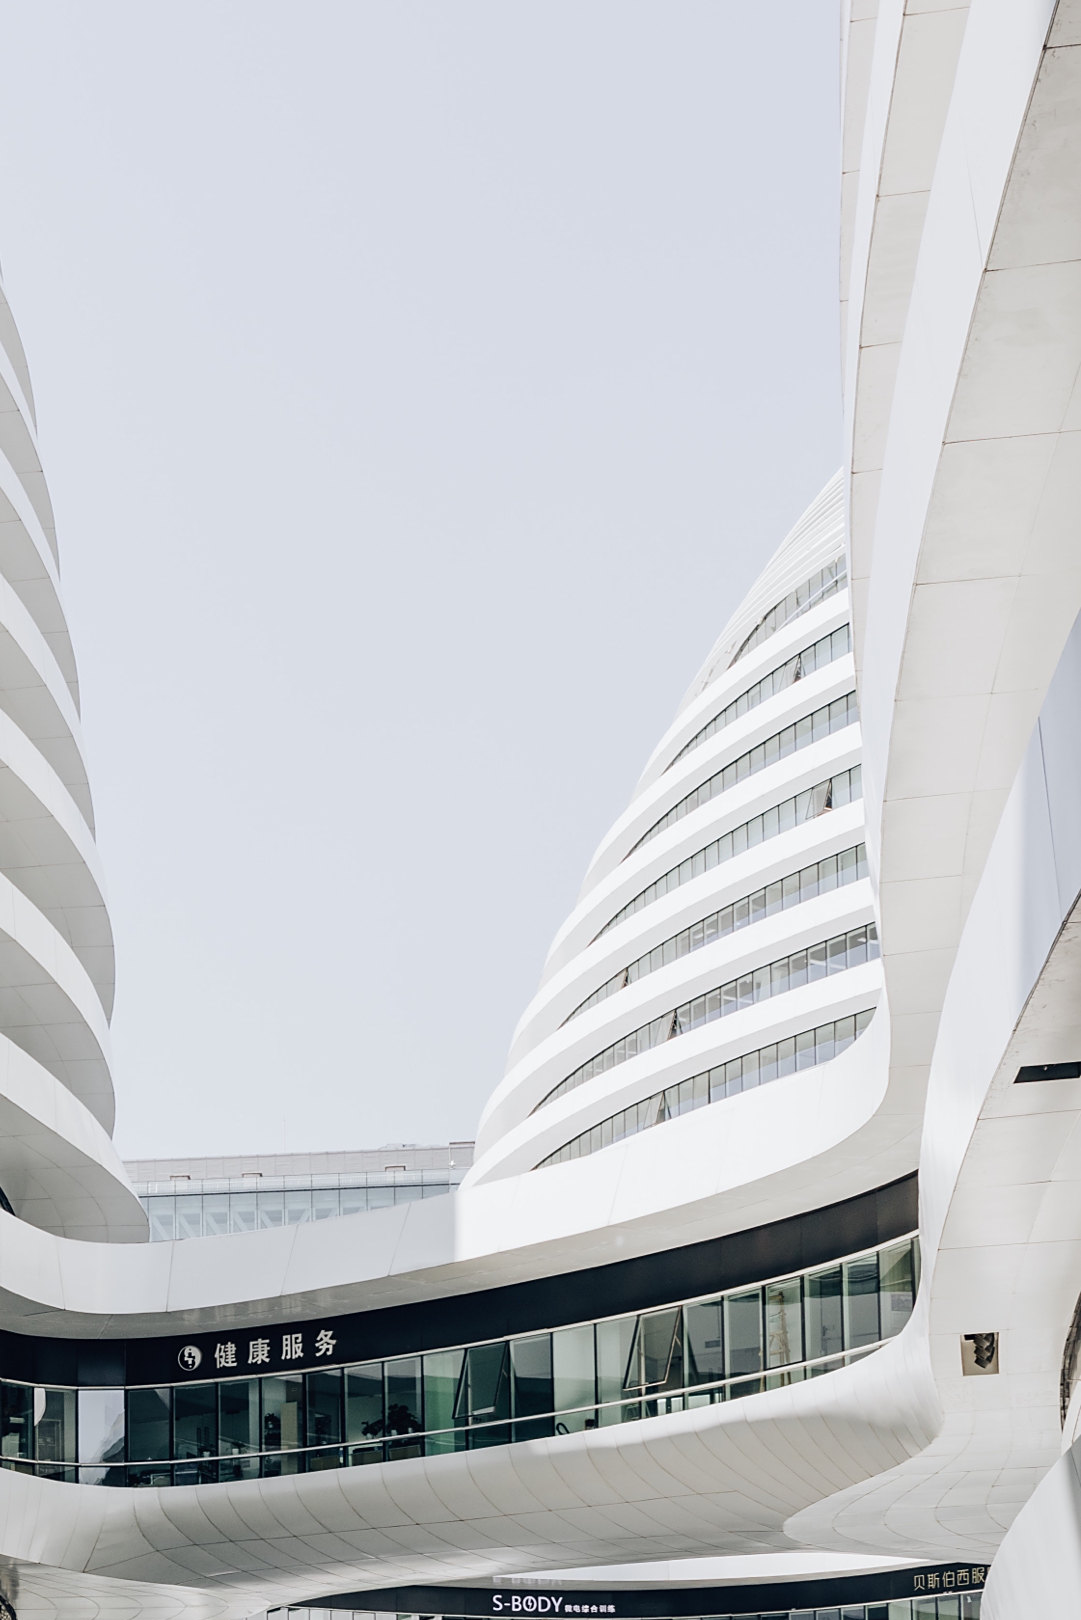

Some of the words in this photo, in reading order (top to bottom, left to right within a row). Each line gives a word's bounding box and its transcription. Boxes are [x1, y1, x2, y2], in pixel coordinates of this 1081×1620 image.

[214, 1329, 337, 1369] 健康服务
[492, 1594, 563, 1613] S-BODY
